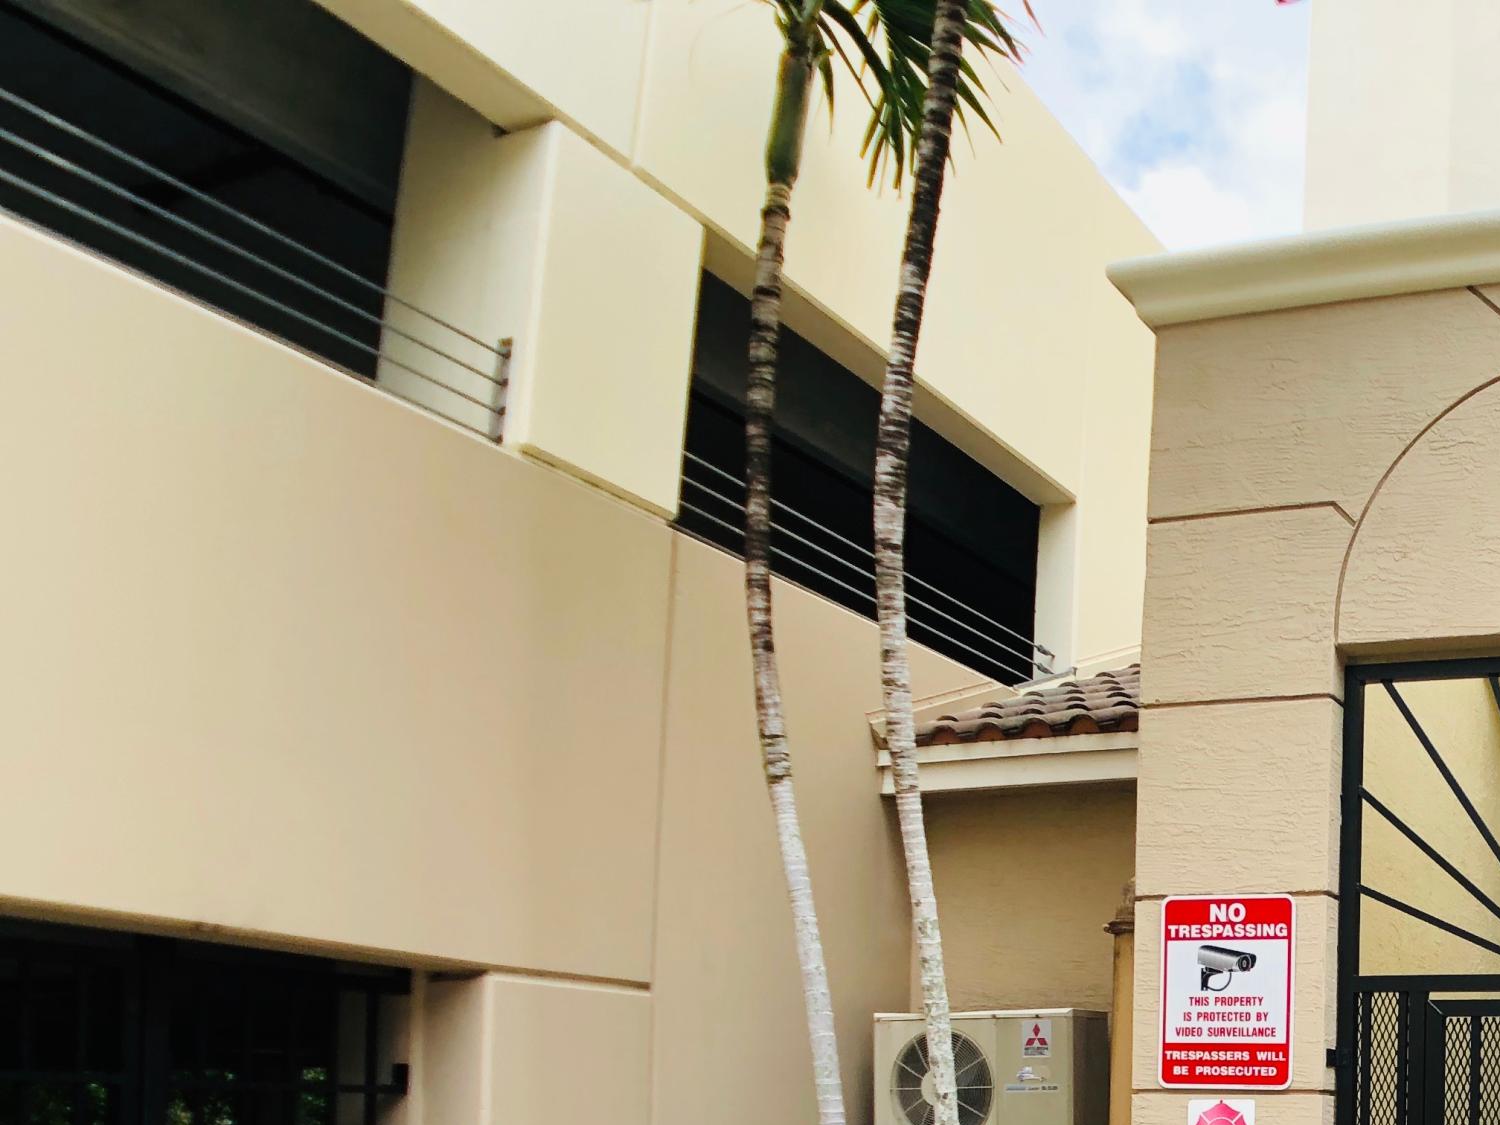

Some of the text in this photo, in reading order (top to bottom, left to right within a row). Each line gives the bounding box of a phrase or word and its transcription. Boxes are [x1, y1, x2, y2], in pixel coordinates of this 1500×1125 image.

[1209, 902, 1247, 923] NO
[1167, 923, 1288, 938] TRESPASSING
[1189, 996, 1264, 1007] THIS PROPERTY
[1183, 1011, 1269, 1022] IS PROTECTED BY
[1175, 1026, 1277, 1037] VIDEO SURVEILLANCE
[1165, 1050, 1287, 1062] TRESPASSERS WILL
[1172, 1065, 1278, 1077] BE PROSECUTED
